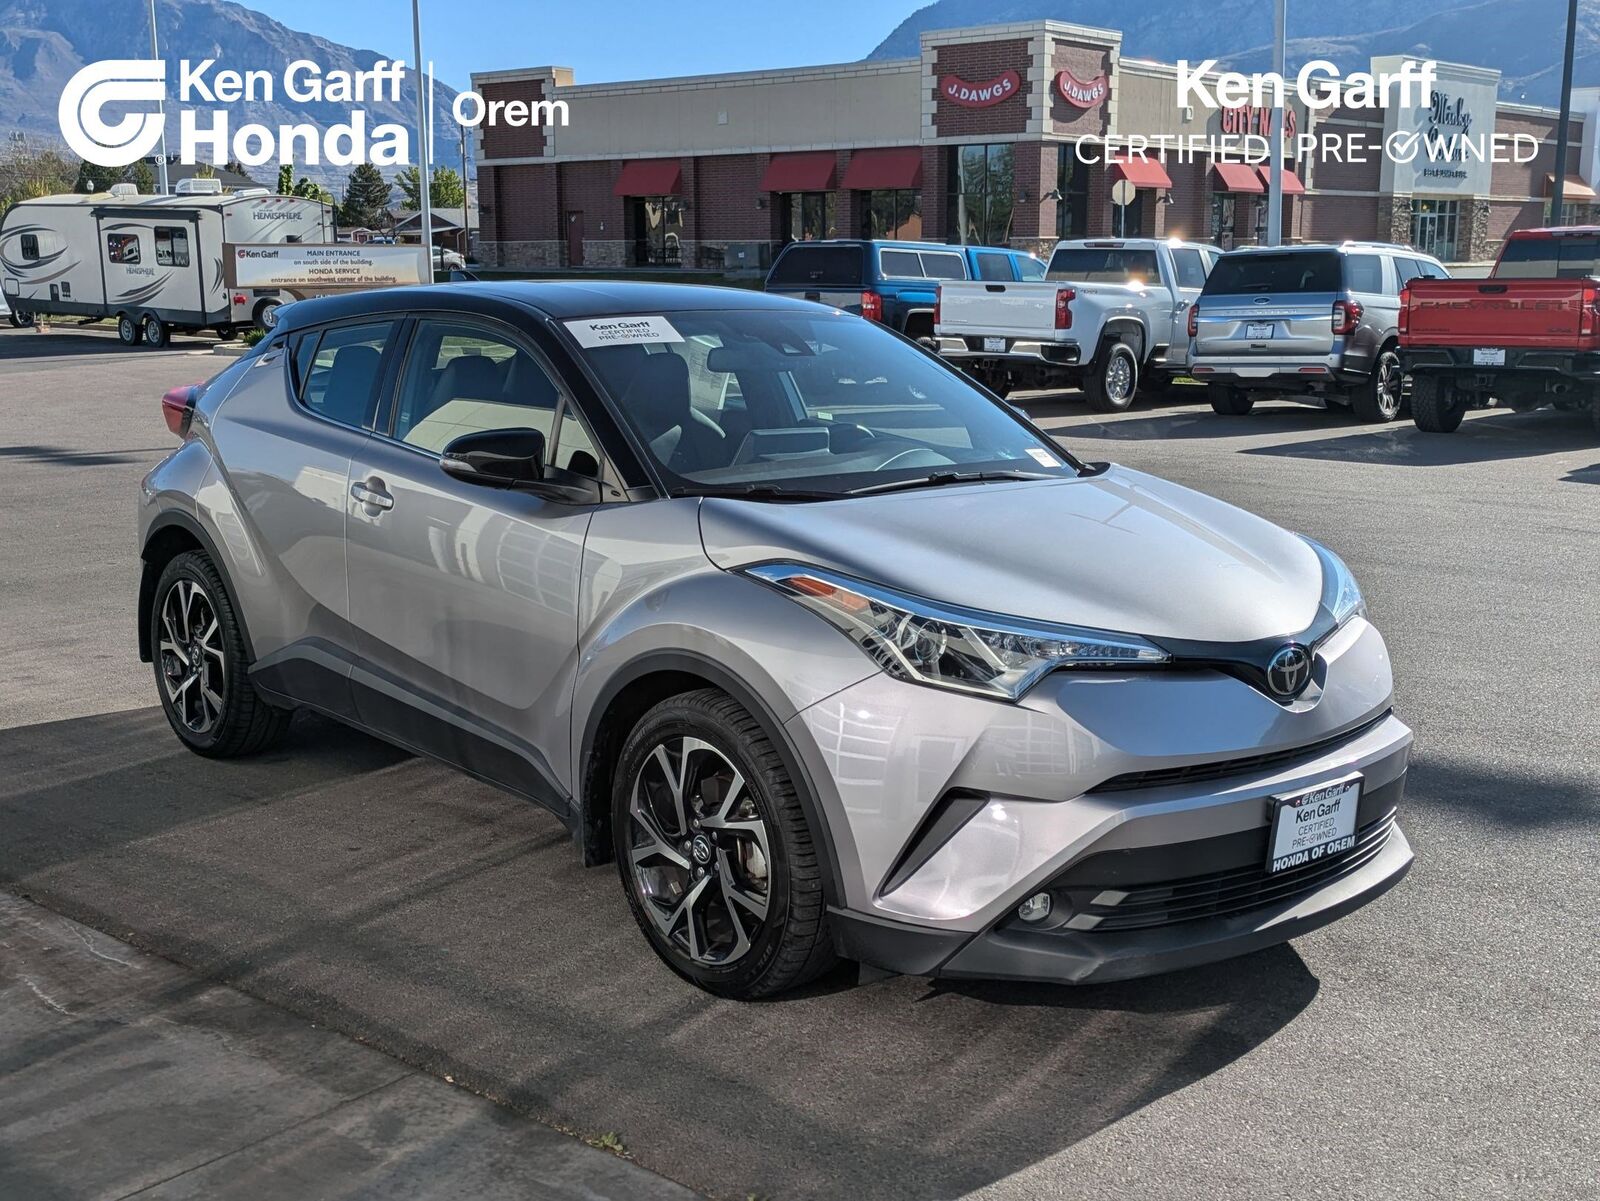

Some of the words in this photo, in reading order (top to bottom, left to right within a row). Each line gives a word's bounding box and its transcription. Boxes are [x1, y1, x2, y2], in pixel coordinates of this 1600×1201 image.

[948, 78, 1012, 102] J.DAWGS
[1063, 81, 1104, 102] J.DAWGS
[246, 250, 260, 258] Ken
[261, 250, 279, 258] Garff
[350, 259, 373, 267] building.
[589, 322, 618, 331] Ken
[618, 321, 650, 329] Garff
[601, 328, 650, 336] CERTIFIED
[1295, 808, 1318, 824] Ken
[1317, 798, 1342, 817] Garff
[1298, 818, 1335, 836] CERTIFIED
[1272, 851, 1309, 873] HONDA
[1311, 846, 1326, 859] OF
[1327, 836, 1356, 853] OREM
